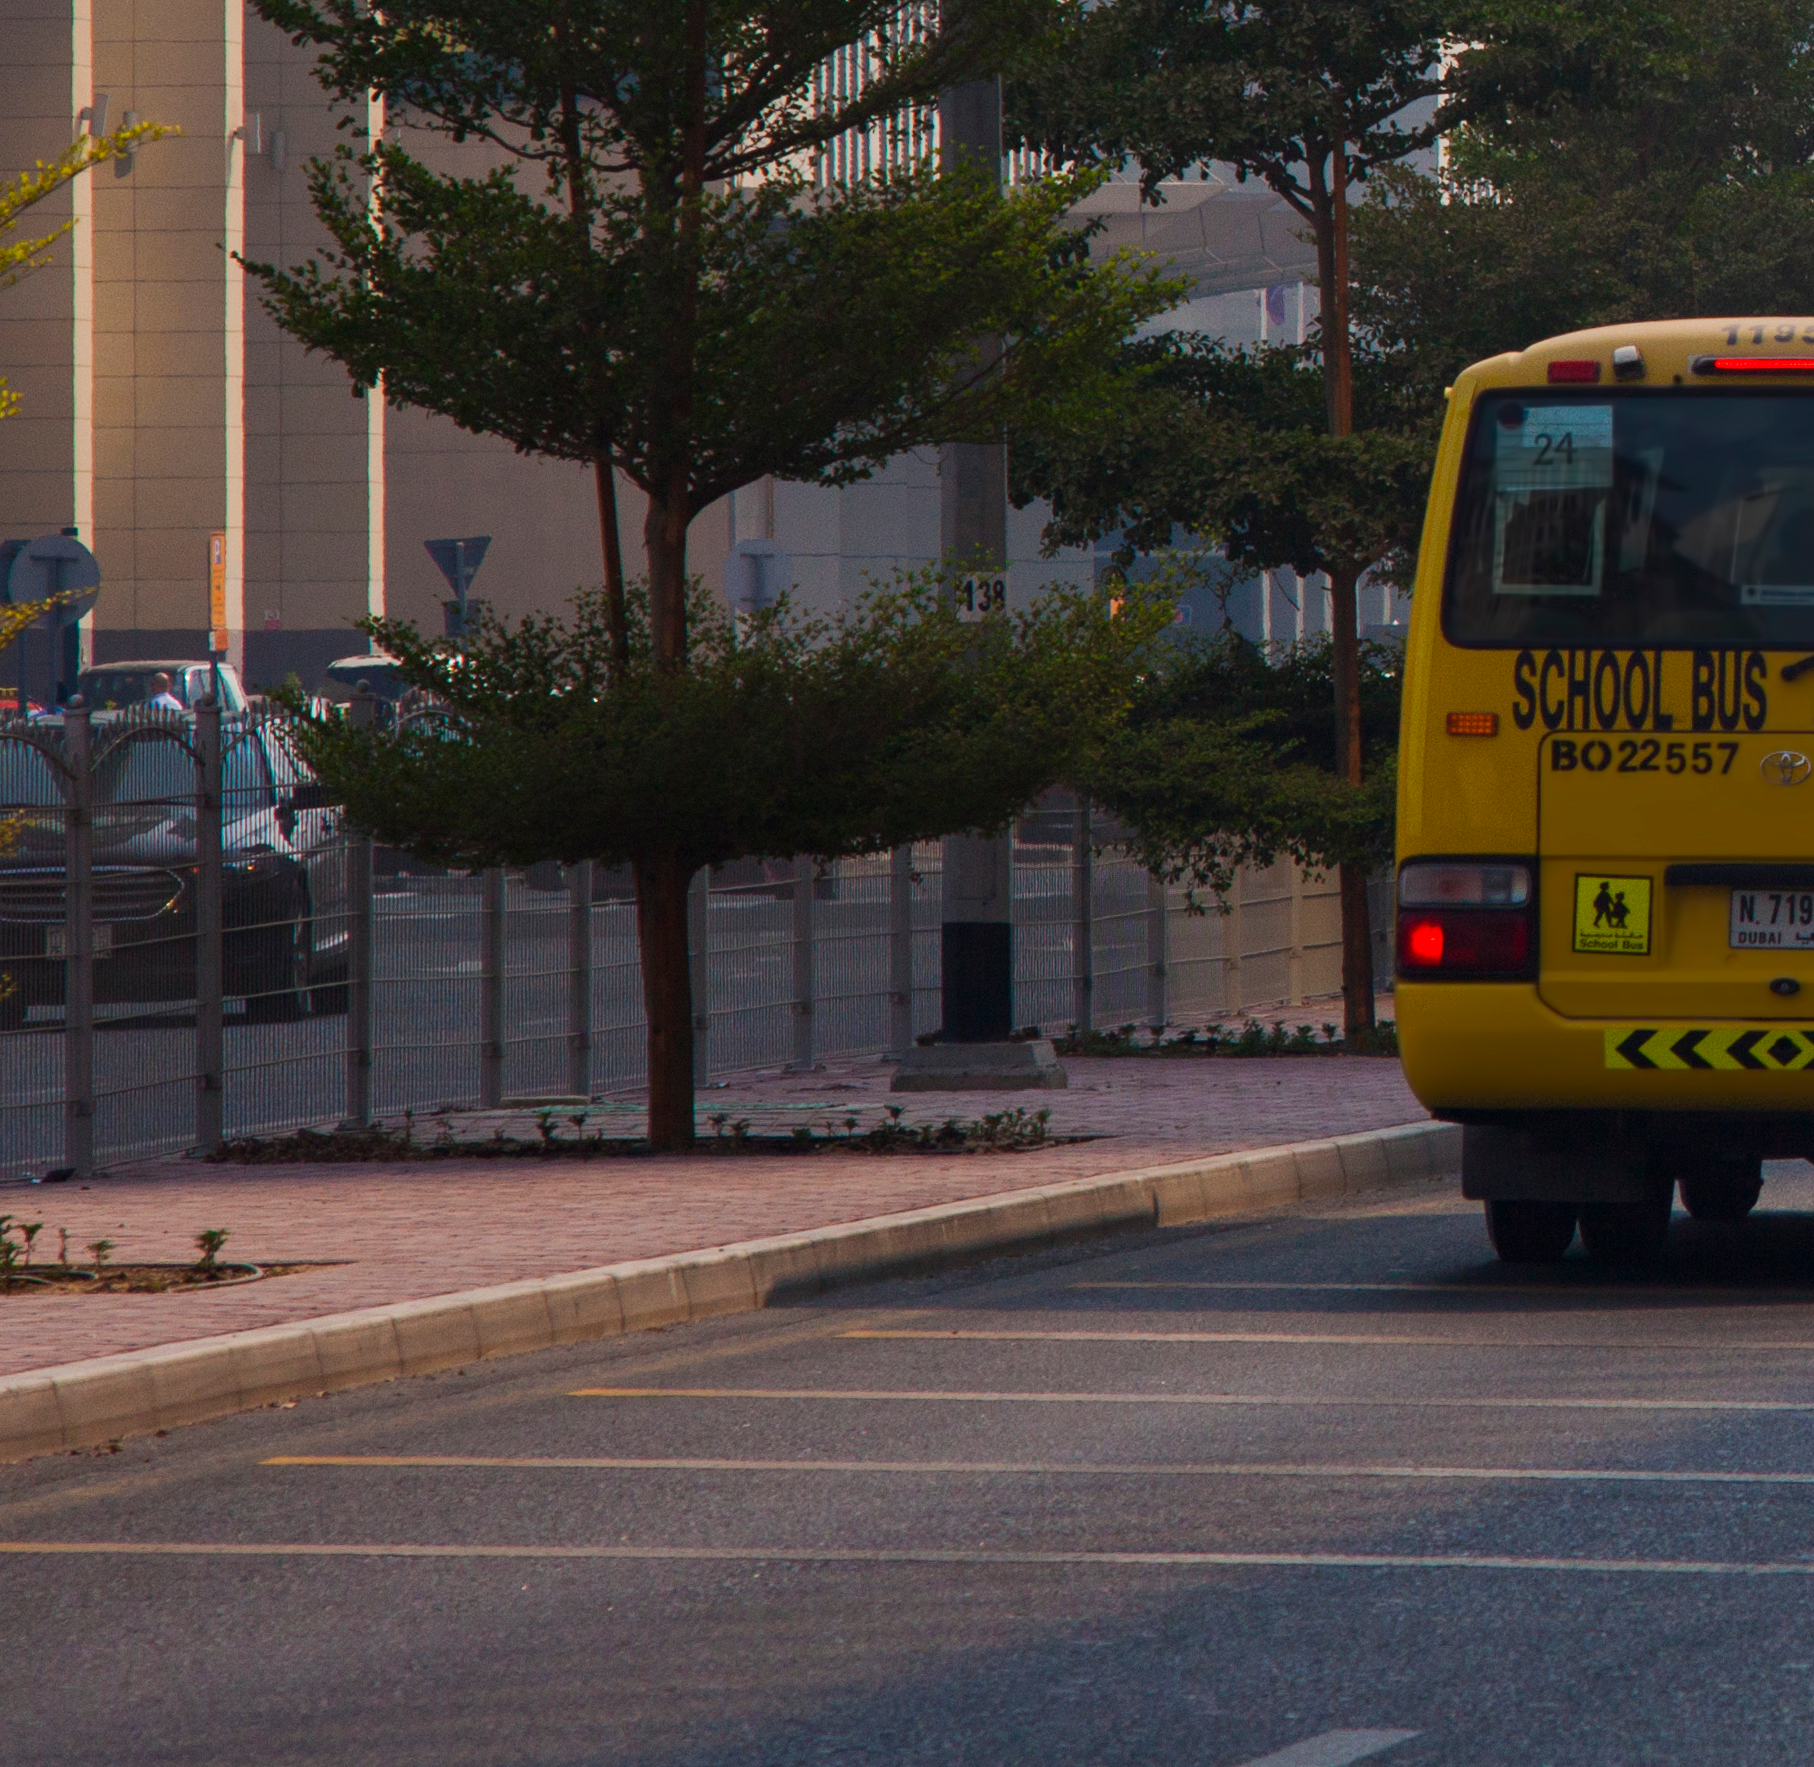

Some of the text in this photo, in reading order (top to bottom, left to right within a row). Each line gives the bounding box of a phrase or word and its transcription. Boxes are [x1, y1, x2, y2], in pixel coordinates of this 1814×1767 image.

[1533, 432, 1578, 466] 24
[964, 579, 1005, 611] 138
[1512, 649, 1768, 731] SCHOOL BUS
[1579, 938, 1644, 950] School Bus
[1738, 931, 1782, 945] DUBAI
